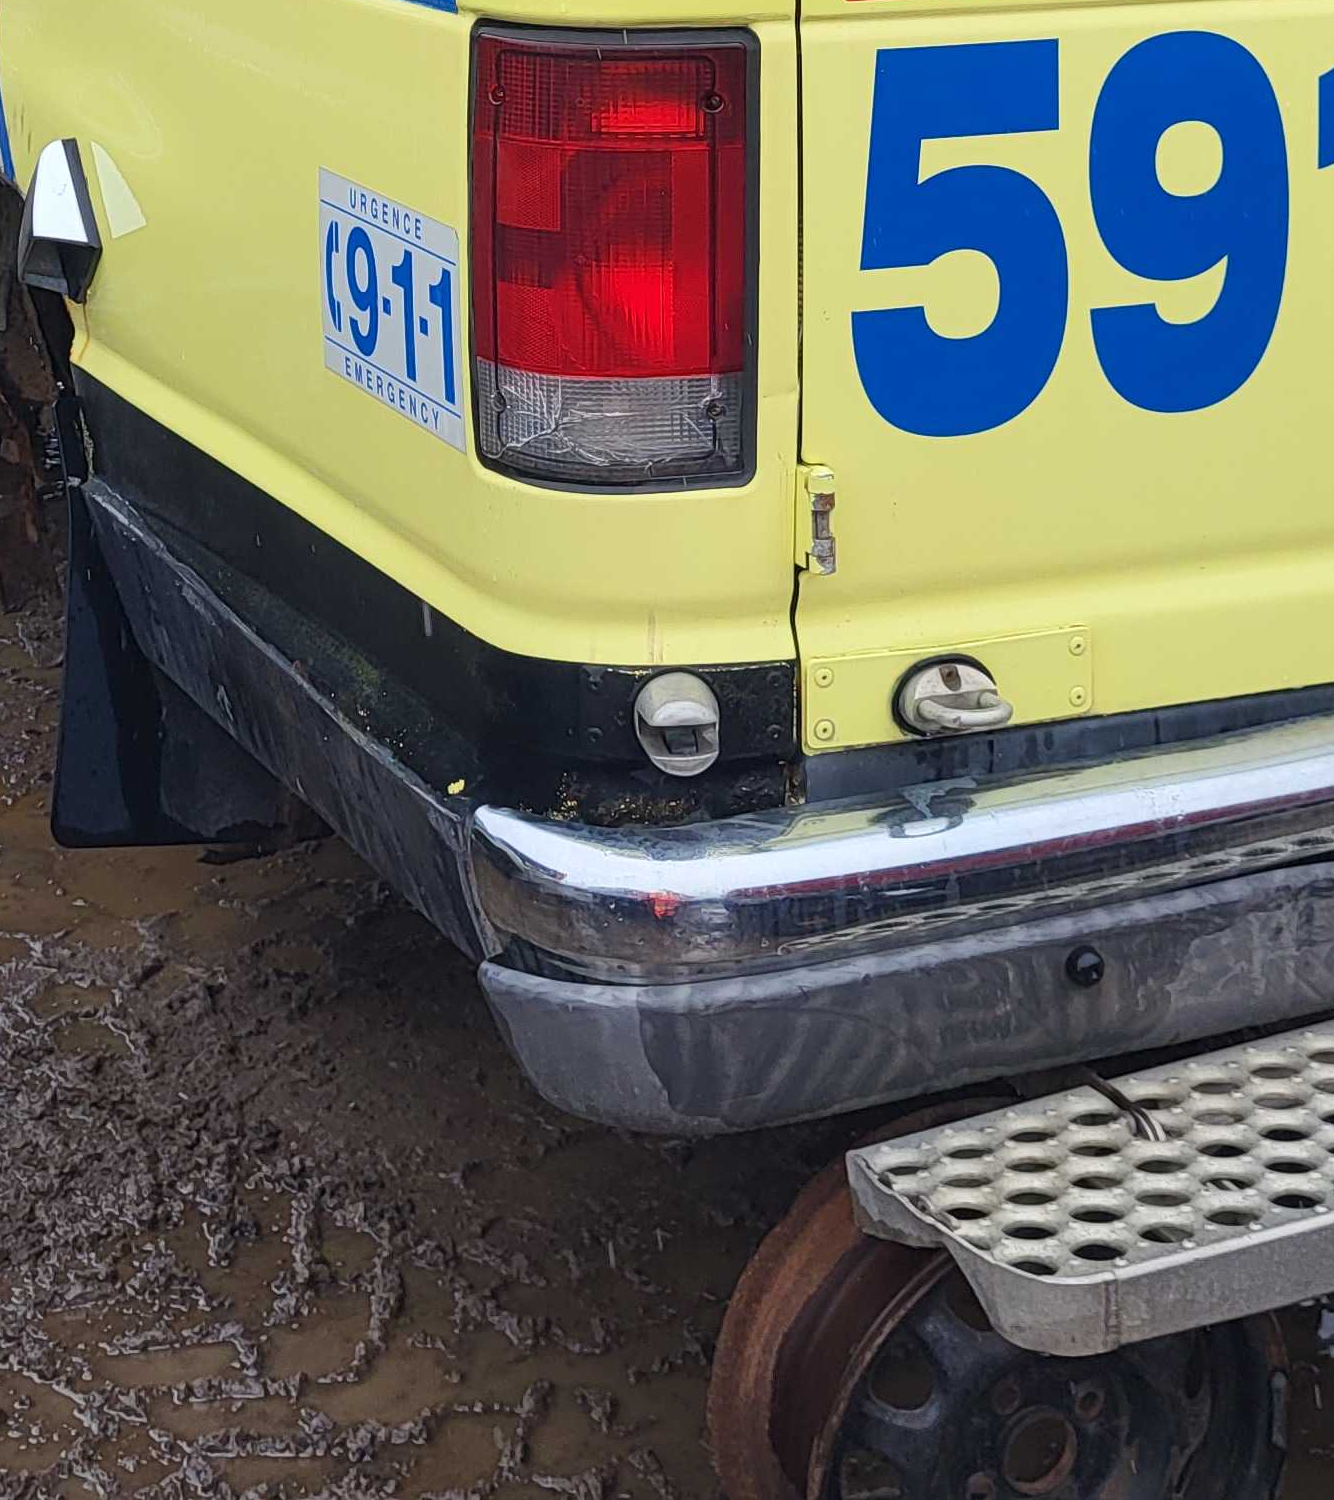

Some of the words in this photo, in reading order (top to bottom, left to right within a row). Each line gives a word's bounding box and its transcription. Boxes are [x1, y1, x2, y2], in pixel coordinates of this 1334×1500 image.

[349, 188, 422, 240] URGENCE
[346, 226, 455, 405] 9-1-1
[345, 356, 441, 430] EMERGENCY
